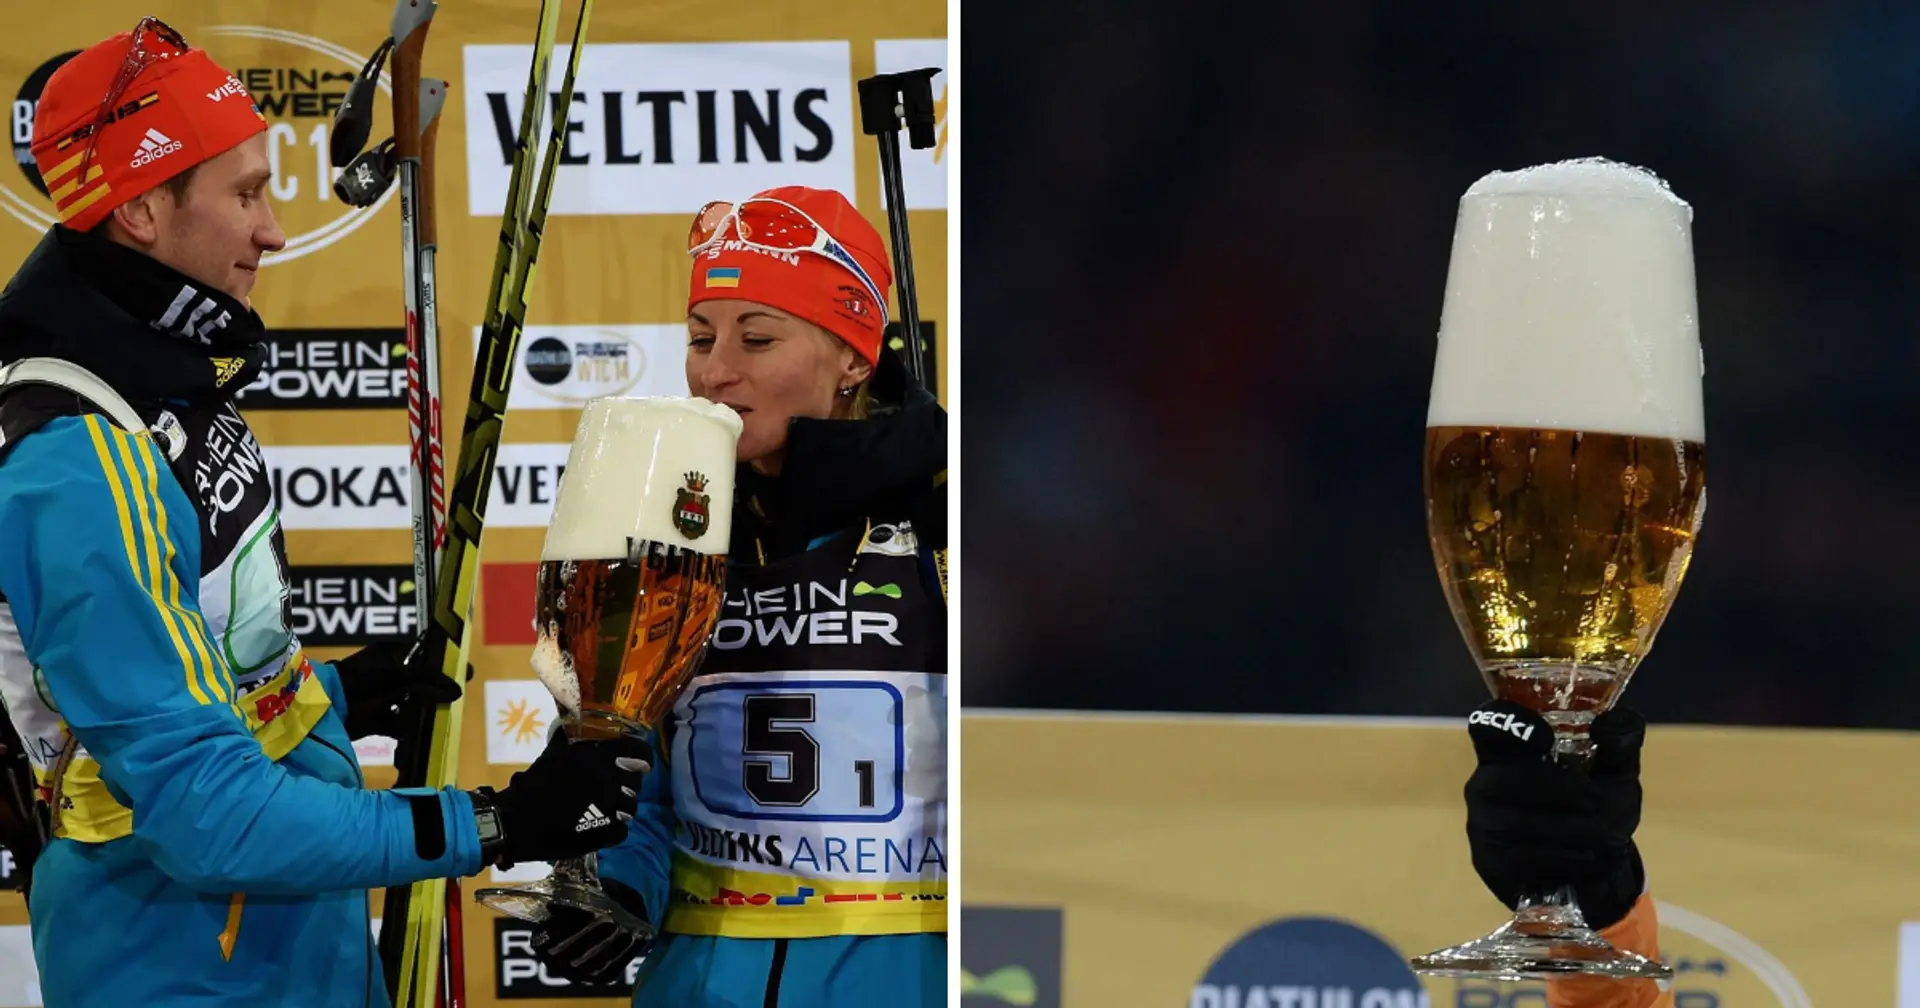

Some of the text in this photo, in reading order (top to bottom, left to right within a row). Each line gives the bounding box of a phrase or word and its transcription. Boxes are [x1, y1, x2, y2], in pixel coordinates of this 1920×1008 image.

[486, 88, 834, 165] VELTINS
[130, 140, 183, 169] adidas
[261, 340, 389, 368] HEIN
[216, 356, 246, 389] adidas
[496, 464, 568, 505] VE
[743, 693, 875, 808] 5 1
[575, 817, 611, 833] adidas
[789, 837, 947, 873] ARENA
